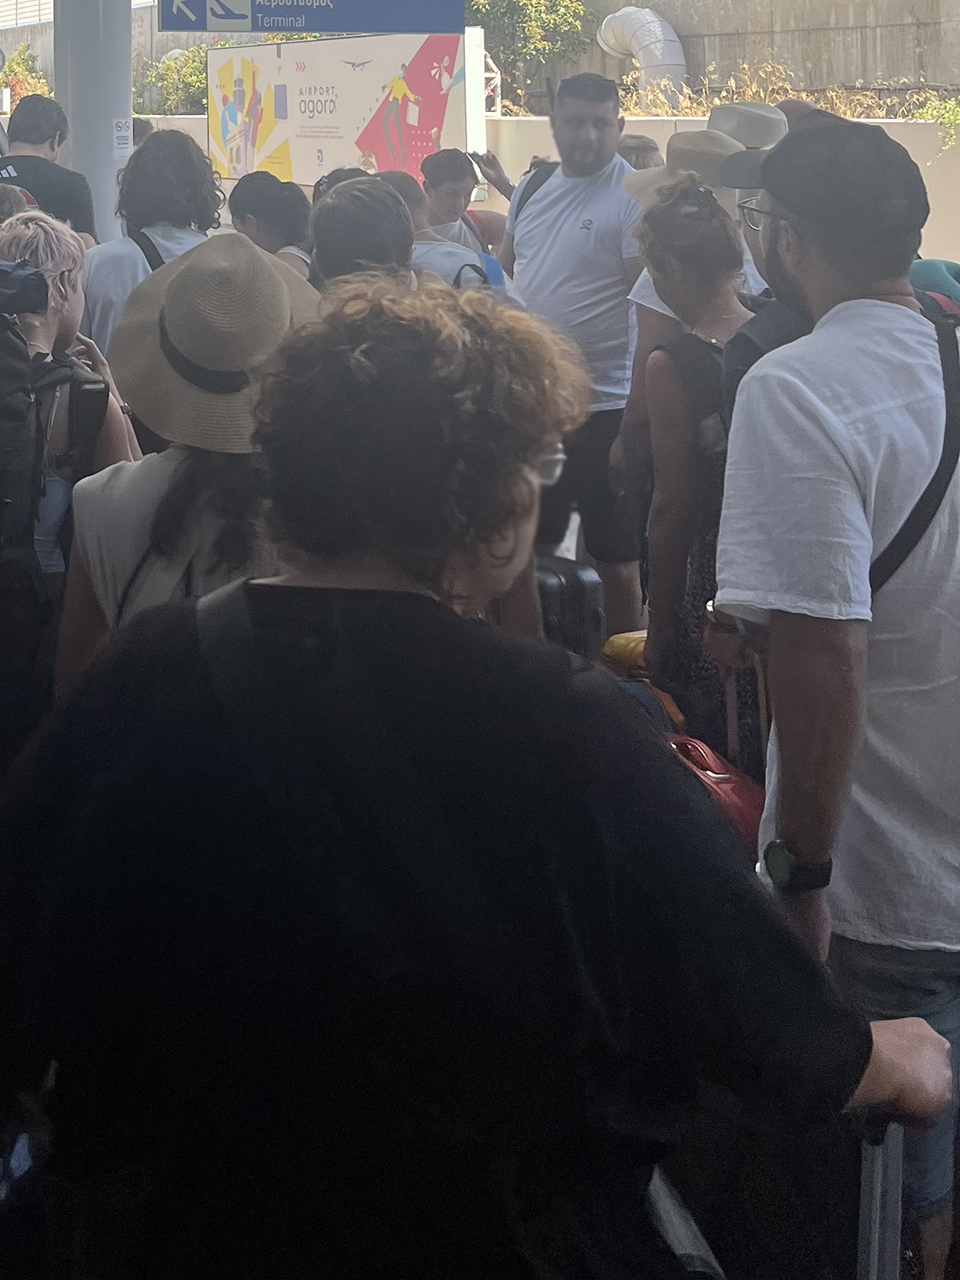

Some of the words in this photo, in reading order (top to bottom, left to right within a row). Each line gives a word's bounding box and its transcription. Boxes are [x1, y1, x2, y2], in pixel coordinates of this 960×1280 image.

[256, 13, 306, 28] Terminal
[299, 87, 335, 96] AIRPORT
[299, 99, 337, 119] agora
